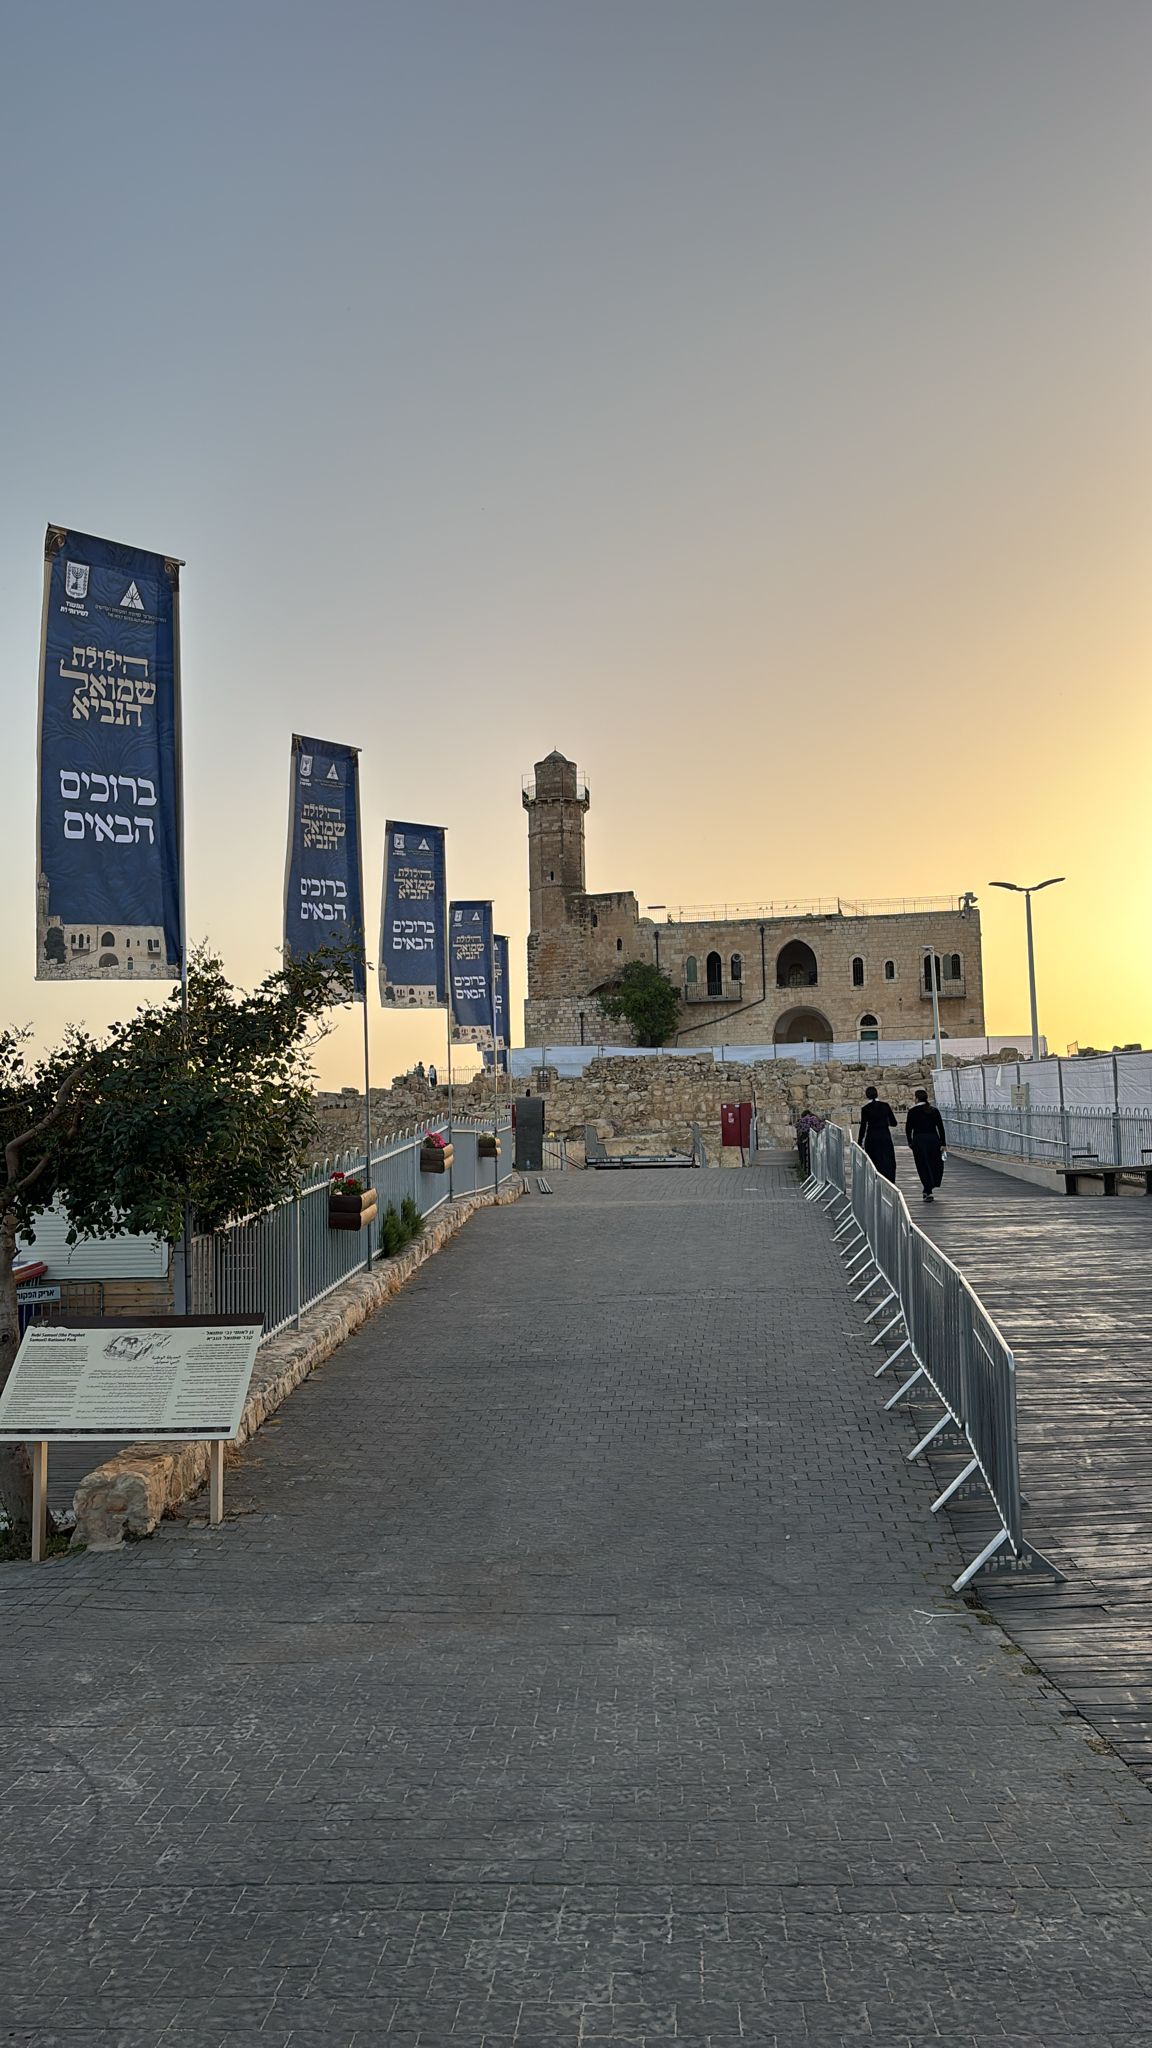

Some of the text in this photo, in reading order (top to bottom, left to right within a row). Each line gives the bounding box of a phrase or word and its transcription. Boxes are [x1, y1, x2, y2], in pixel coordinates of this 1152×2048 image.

[71, 646, 149, 677] הילולת
[59, 658, 156, 705] שמואל
[72, 694, 142, 728] הנביא
[60, 769, 157, 806] ברוכים
[303, 803, 341, 820] הילולת
[63, 809, 155, 845] הבאים
[300, 813, 346, 837] שמואל
[303, 833, 338, 851] הנביא
[300, 877, 348, 898] ברוכים
[393, 875, 436, 891] שמואל
[398, 888, 430, 900] הנביא
[300, 901, 347, 921] הבאים
[392, 920, 435, 934] ברוכים
[392, 937, 434, 950] הבאים
[454, 975, 486, 987] ברוכים
[455, 988, 486, 1000] הבאים
